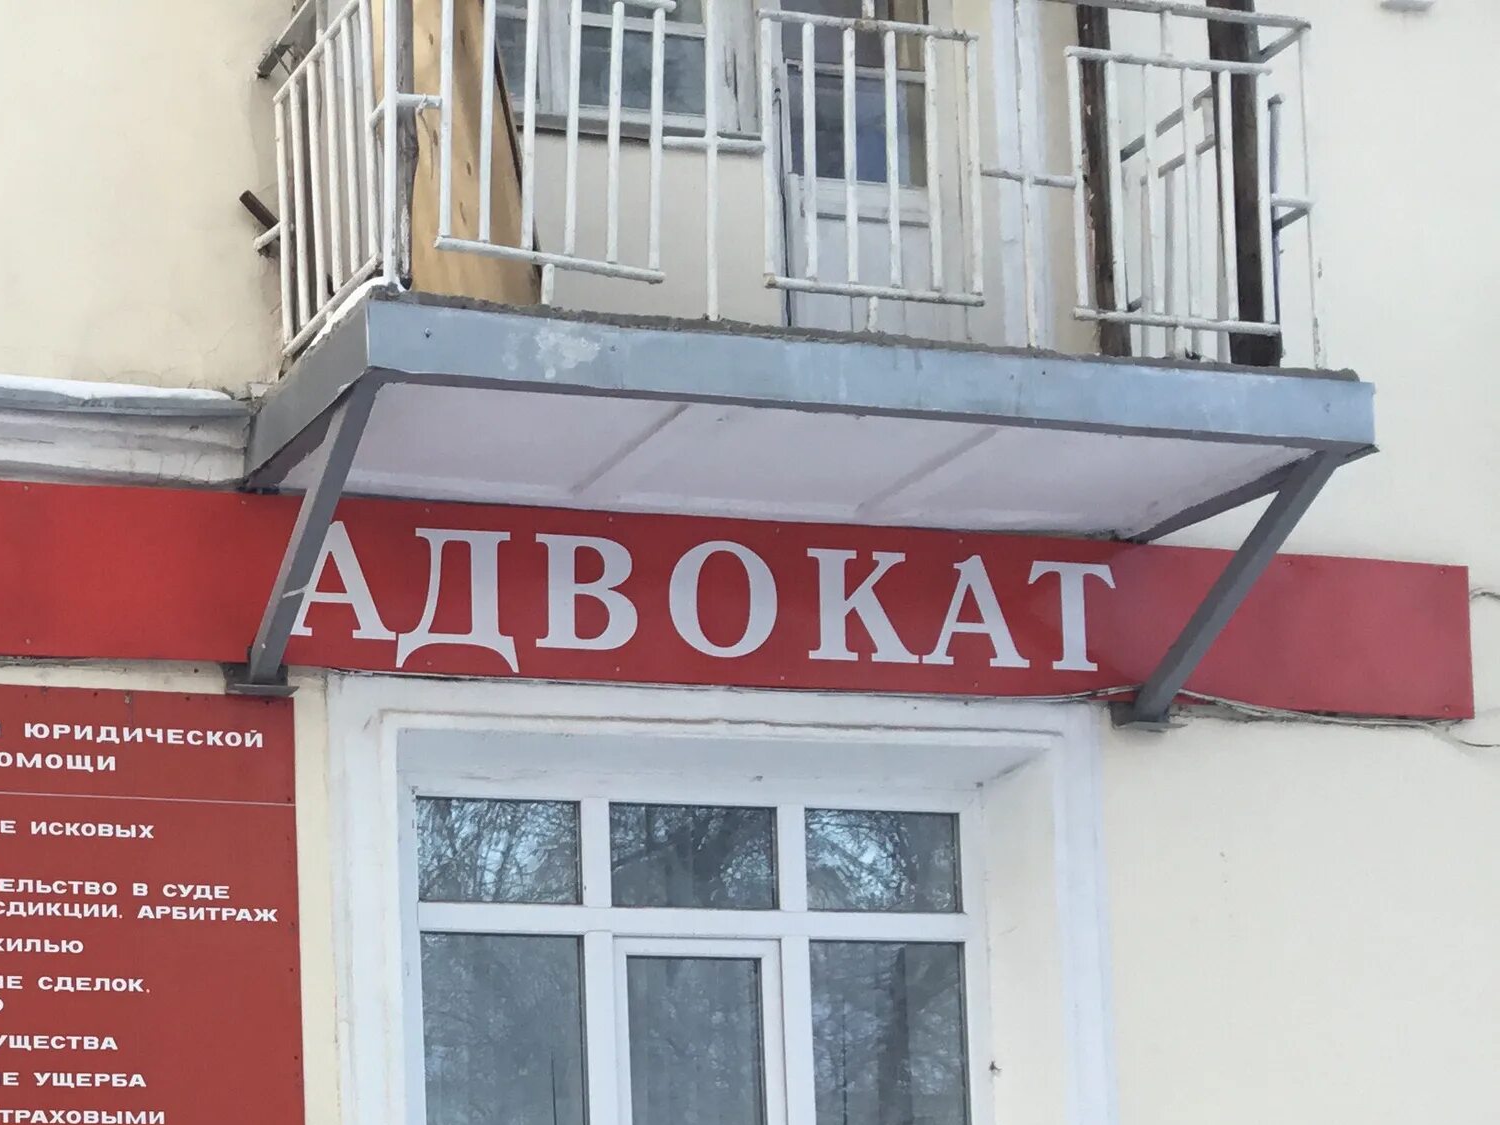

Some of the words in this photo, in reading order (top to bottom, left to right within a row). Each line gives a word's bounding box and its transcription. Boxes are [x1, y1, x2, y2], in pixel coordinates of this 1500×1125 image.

[290, 520, 1117, 673] АДВОКАТ
[25, 723, 262, 747] ЮРИДИЧЕСКОЙ
[31, 822, 153, 838] ИСКОВЫХ
[133, 883, 148, 896] В
[163, 884, 229, 900] СУДЕ
[137, 906, 277, 922] АРБИТРАЖ
[34, 1073, 146, 1088] УЩЕРБА
